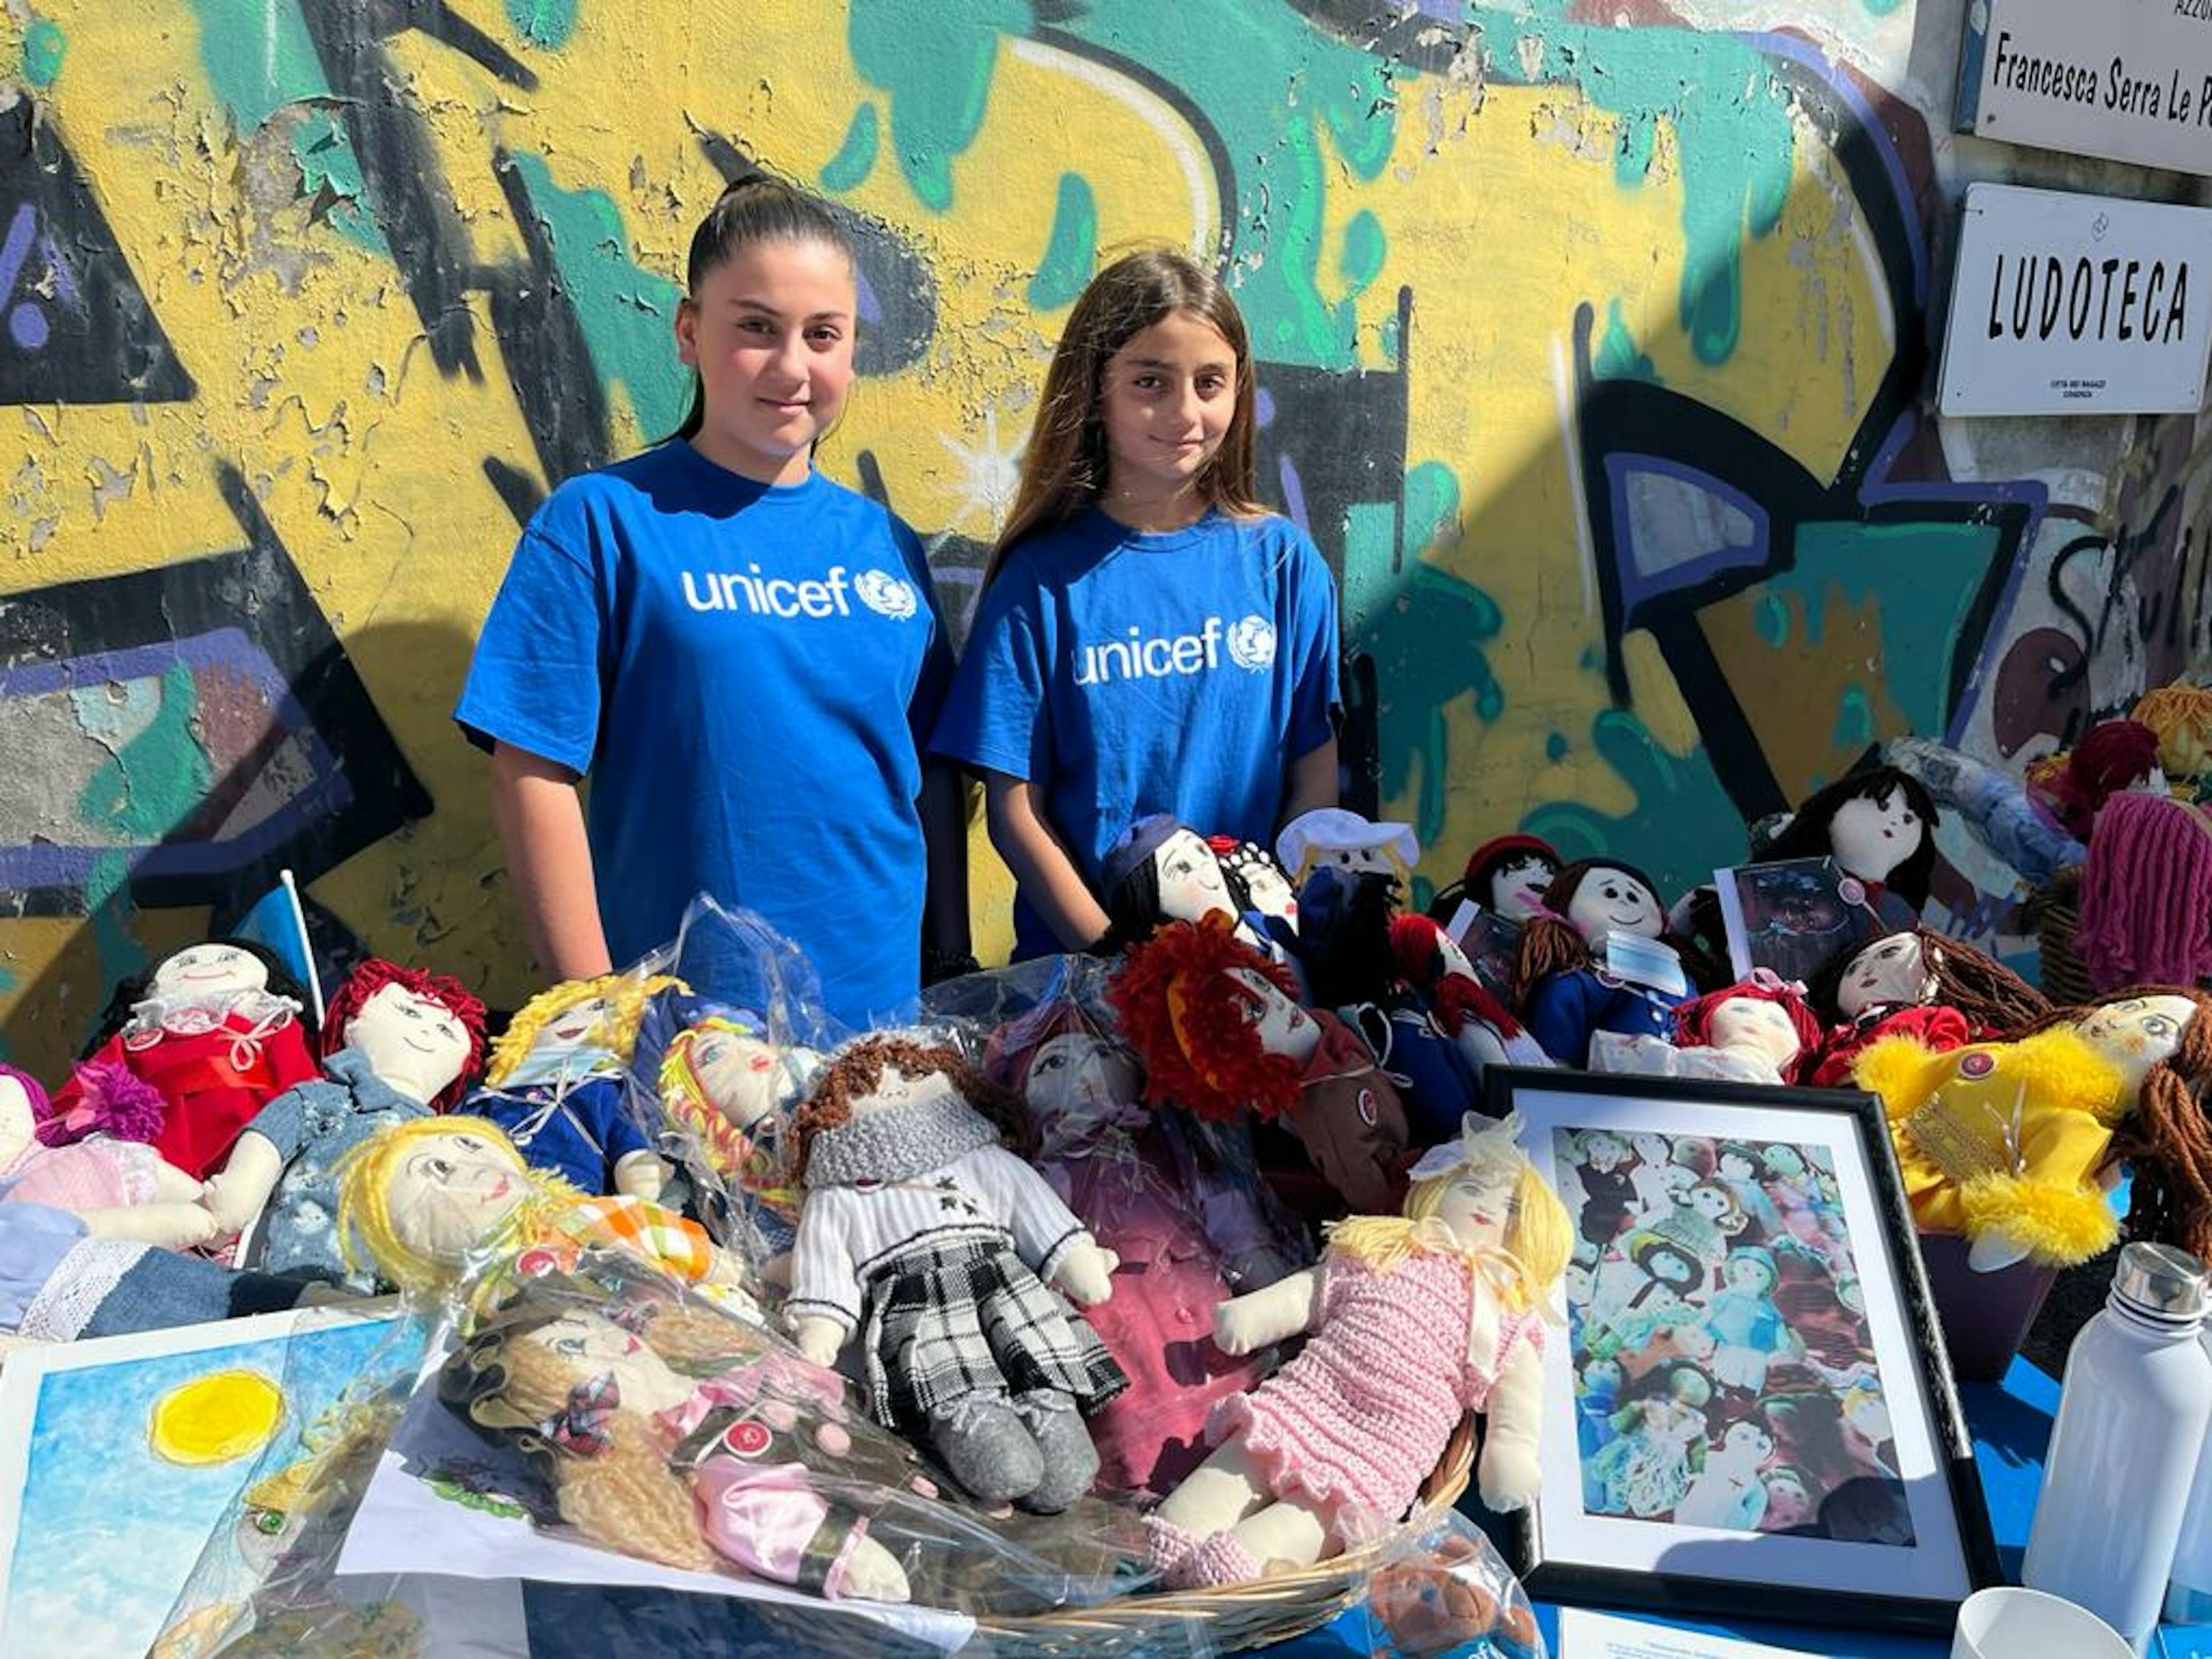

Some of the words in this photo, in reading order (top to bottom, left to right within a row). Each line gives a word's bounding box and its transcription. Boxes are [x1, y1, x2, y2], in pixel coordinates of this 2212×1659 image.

[1993, 32, 2097, 105] Francesca
[2104, 56, 2160, 119] Serra
[2168, 68, 2190, 123] Le
[1989, 254, 2188, 343] LUDOTECA
[681, 562, 850, 618] unicef
[1071, 616, 1222, 685] unicef
